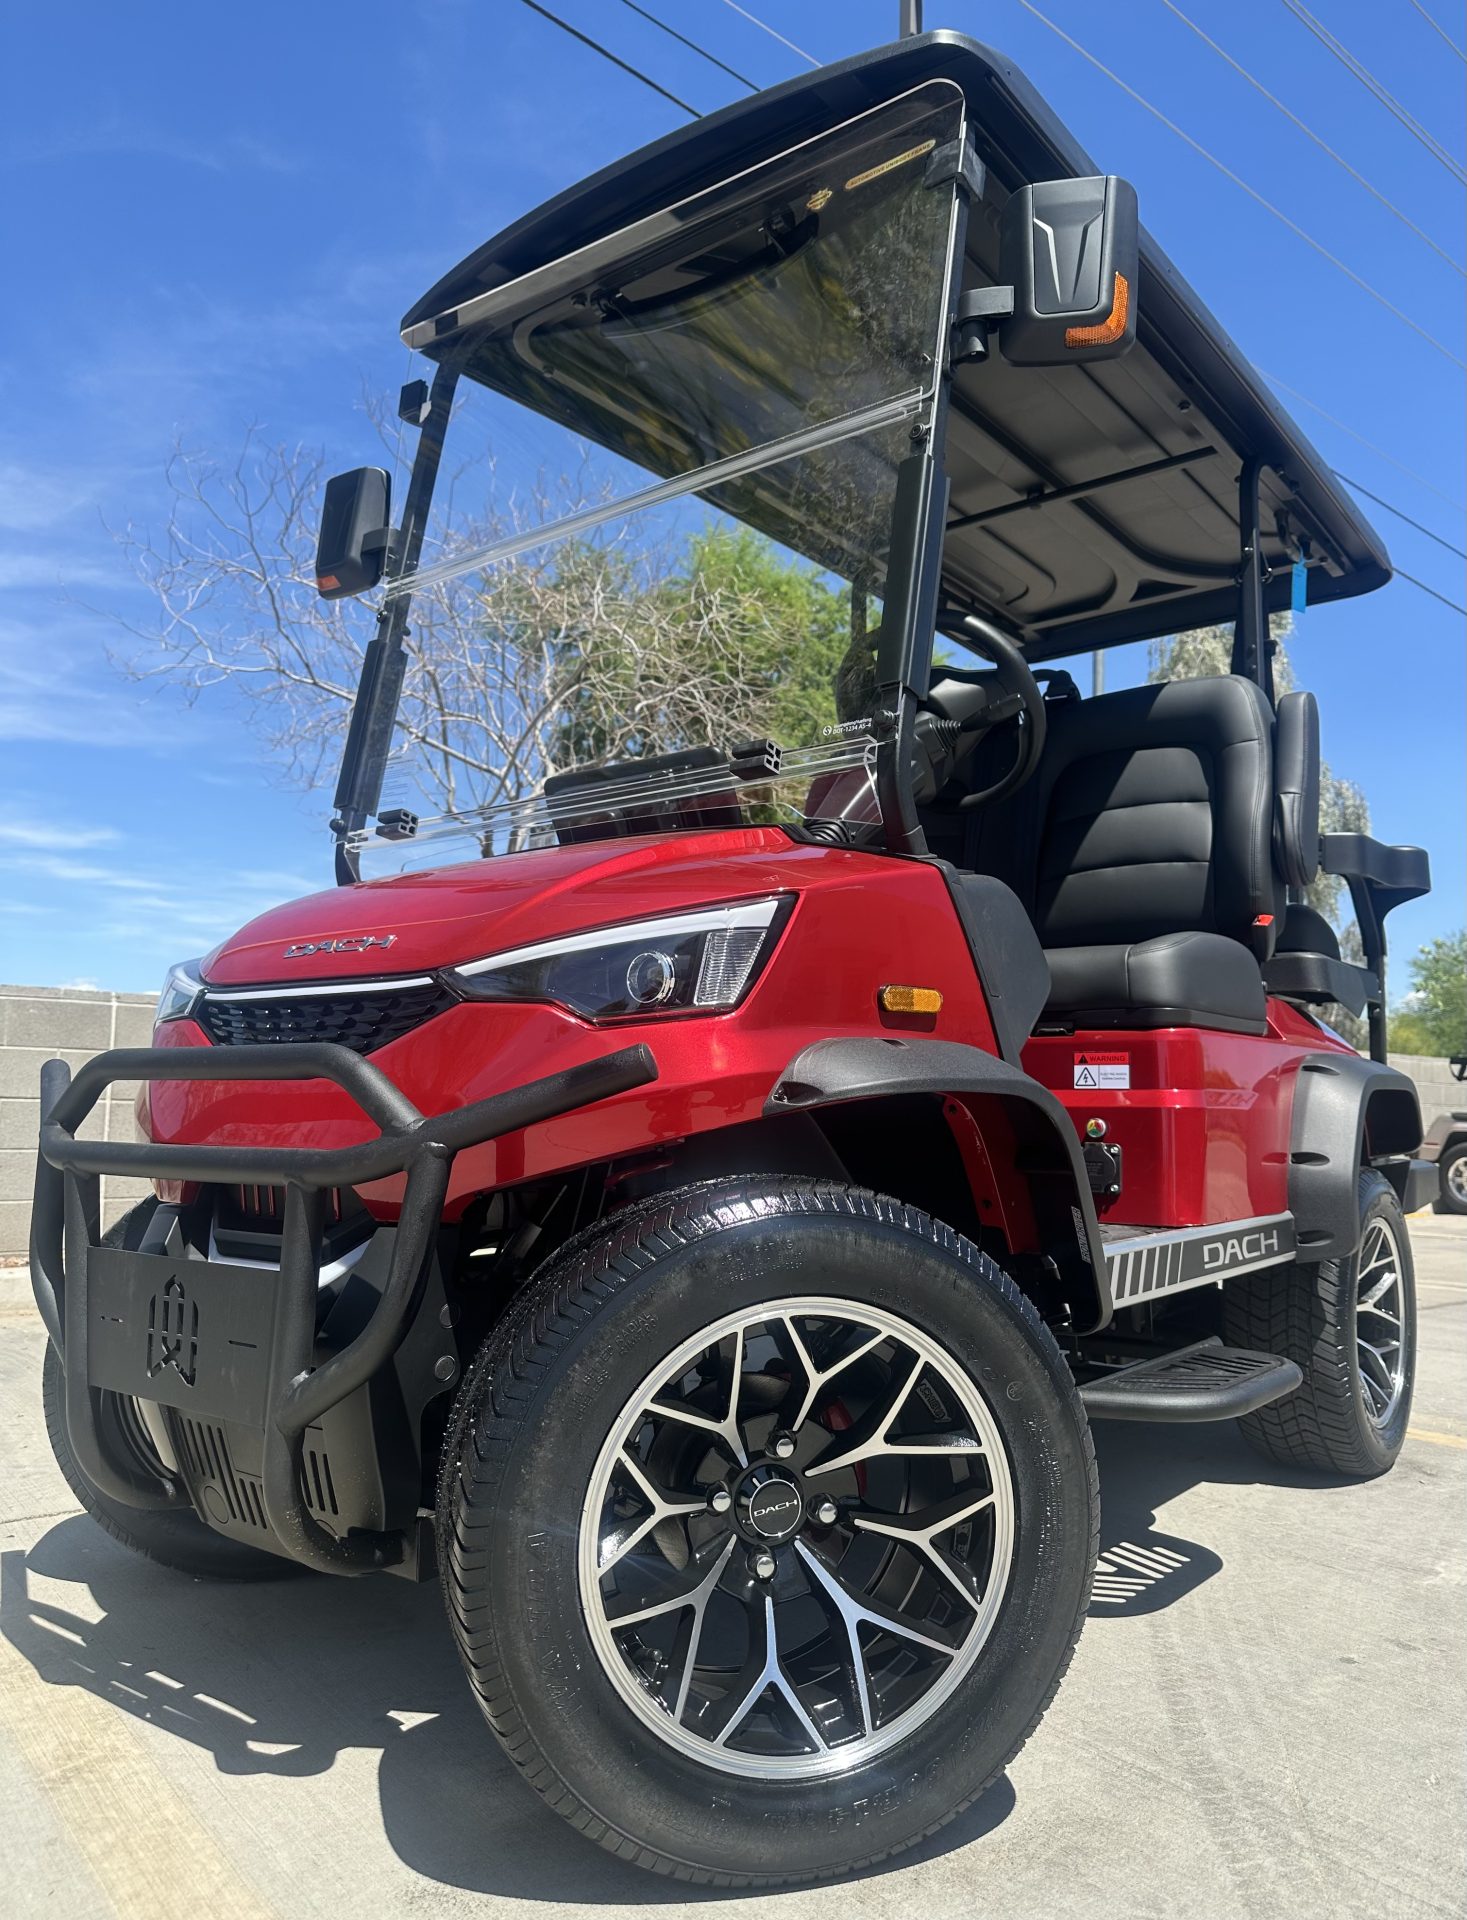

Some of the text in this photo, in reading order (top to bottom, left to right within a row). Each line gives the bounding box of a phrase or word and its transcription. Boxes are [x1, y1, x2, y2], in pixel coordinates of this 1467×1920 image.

[283, 934, 398, 959] DACH
[1089, 1055, 1126, 1063] WARNING
[1203, 1229, 1279, 1270] DACH
[753, 1499, 798, 1518] DACH
